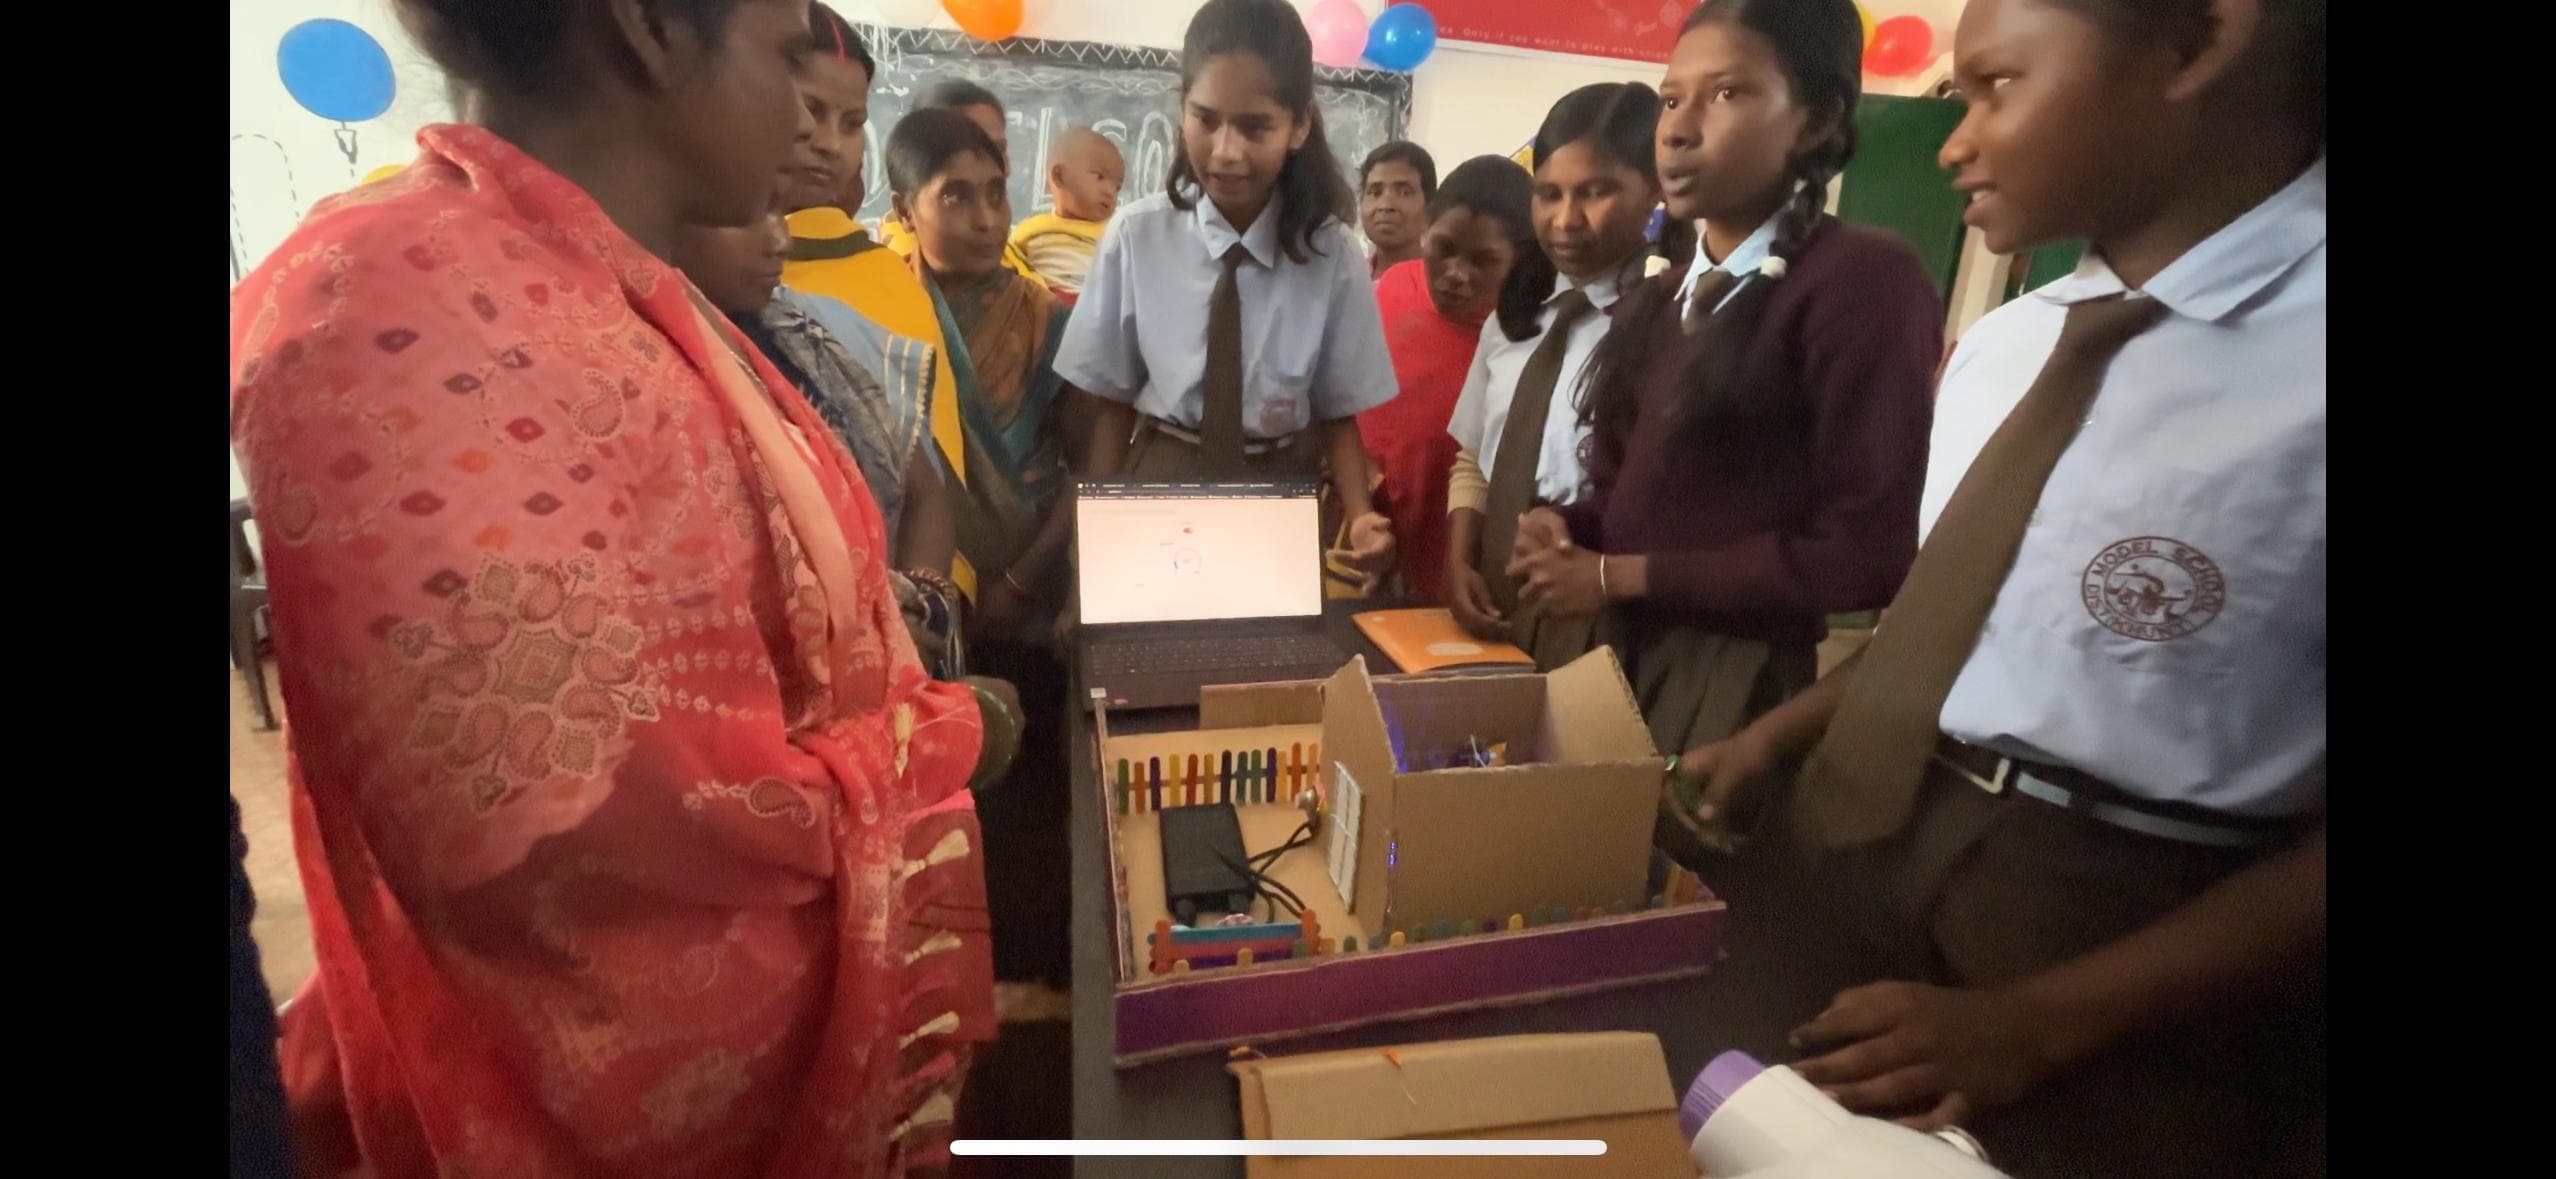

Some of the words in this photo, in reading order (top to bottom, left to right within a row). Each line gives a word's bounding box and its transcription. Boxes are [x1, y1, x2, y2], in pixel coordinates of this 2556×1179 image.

[1463, 27, 1490, 40] Only
[2091, 541, 2158, 577] MODEL
[2173, 546, 2222, 613] SCHOOL
